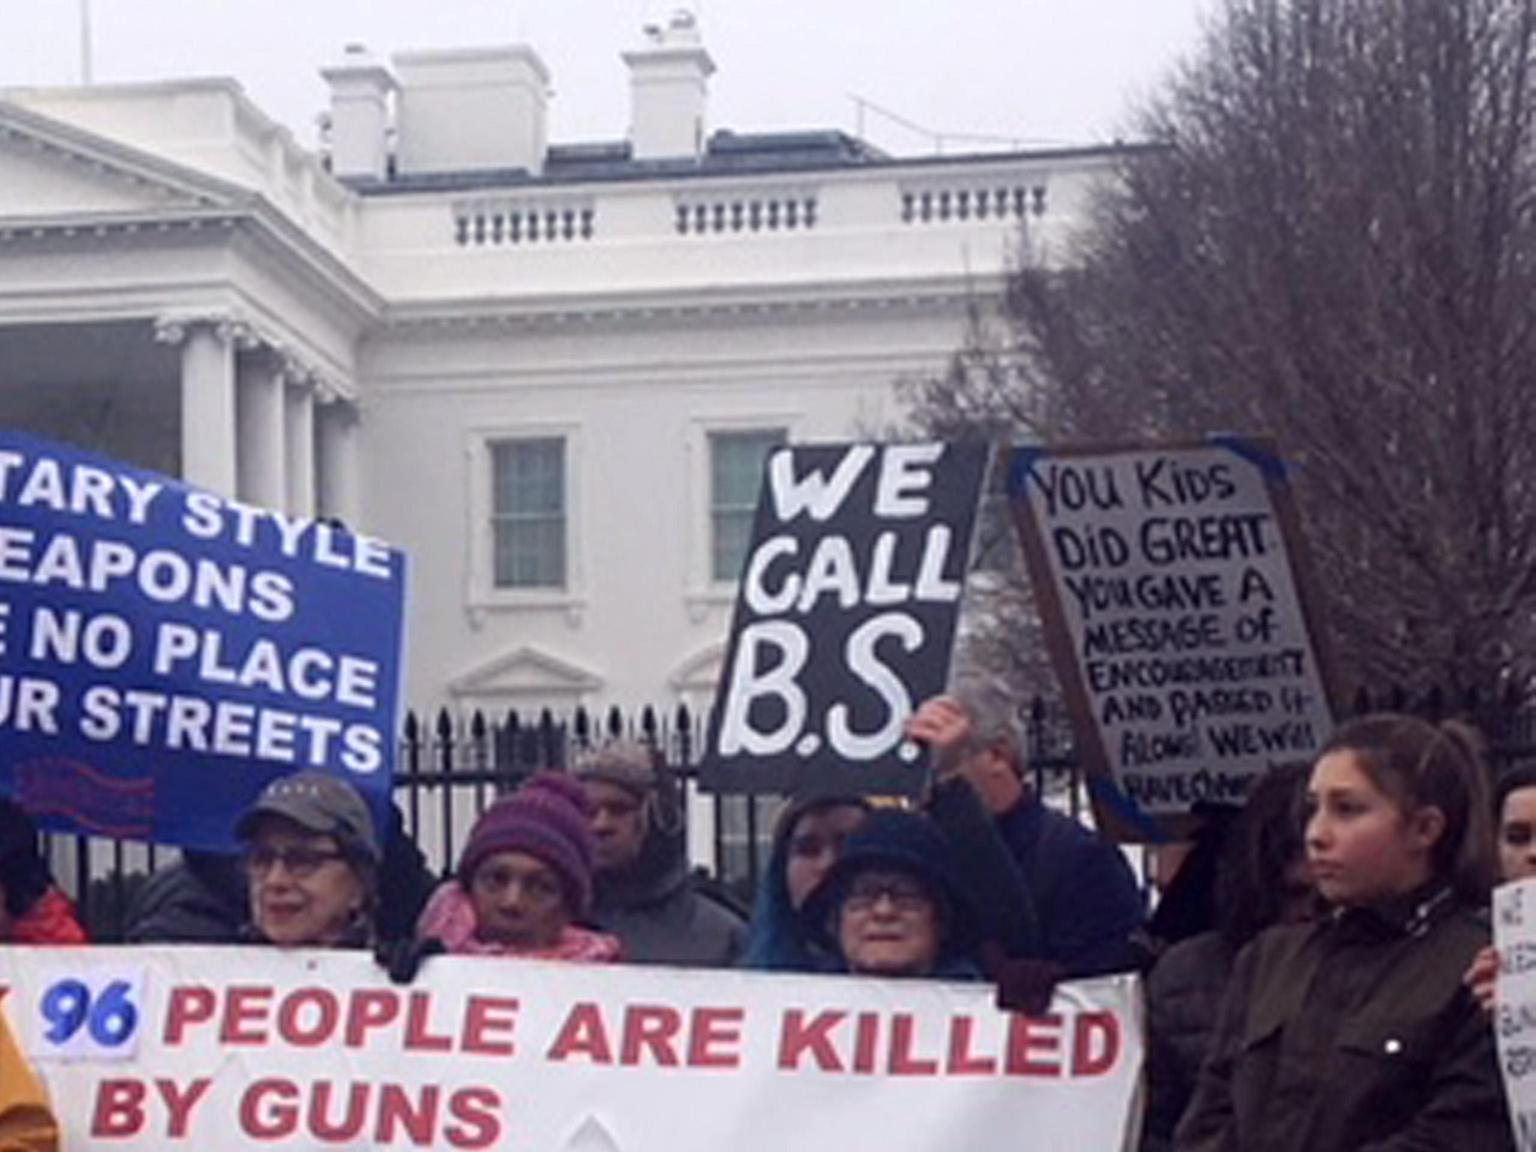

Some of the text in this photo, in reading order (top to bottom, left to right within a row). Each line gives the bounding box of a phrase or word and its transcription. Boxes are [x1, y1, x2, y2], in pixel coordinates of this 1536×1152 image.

[768, 442, 946, 523] WE
[1028, 460, 1124, 513] YOU
[182, 489, 394, 579] STYLE
[744, 524, 962, 616] CALL
[1140, 512, 1270, 566] GREAT
[1137, 572, 1227, 612] GAVE
[1239, 565, 1275, 602] A
[30, 607, 133, 670] NO
[153, 622, 380, 709] PLACE
[1083, 612, 1229, 658] MESSAGE
[717, 611, 925, 763] B.S.
[1103, 695, 1163, 726] AND
[79, 686, 384, 774] STREETS
[39, 978, 1123, 1080] 96 PEOPLE ARE KILLED
[90, 1077, 504, 1150] BY GUNS
